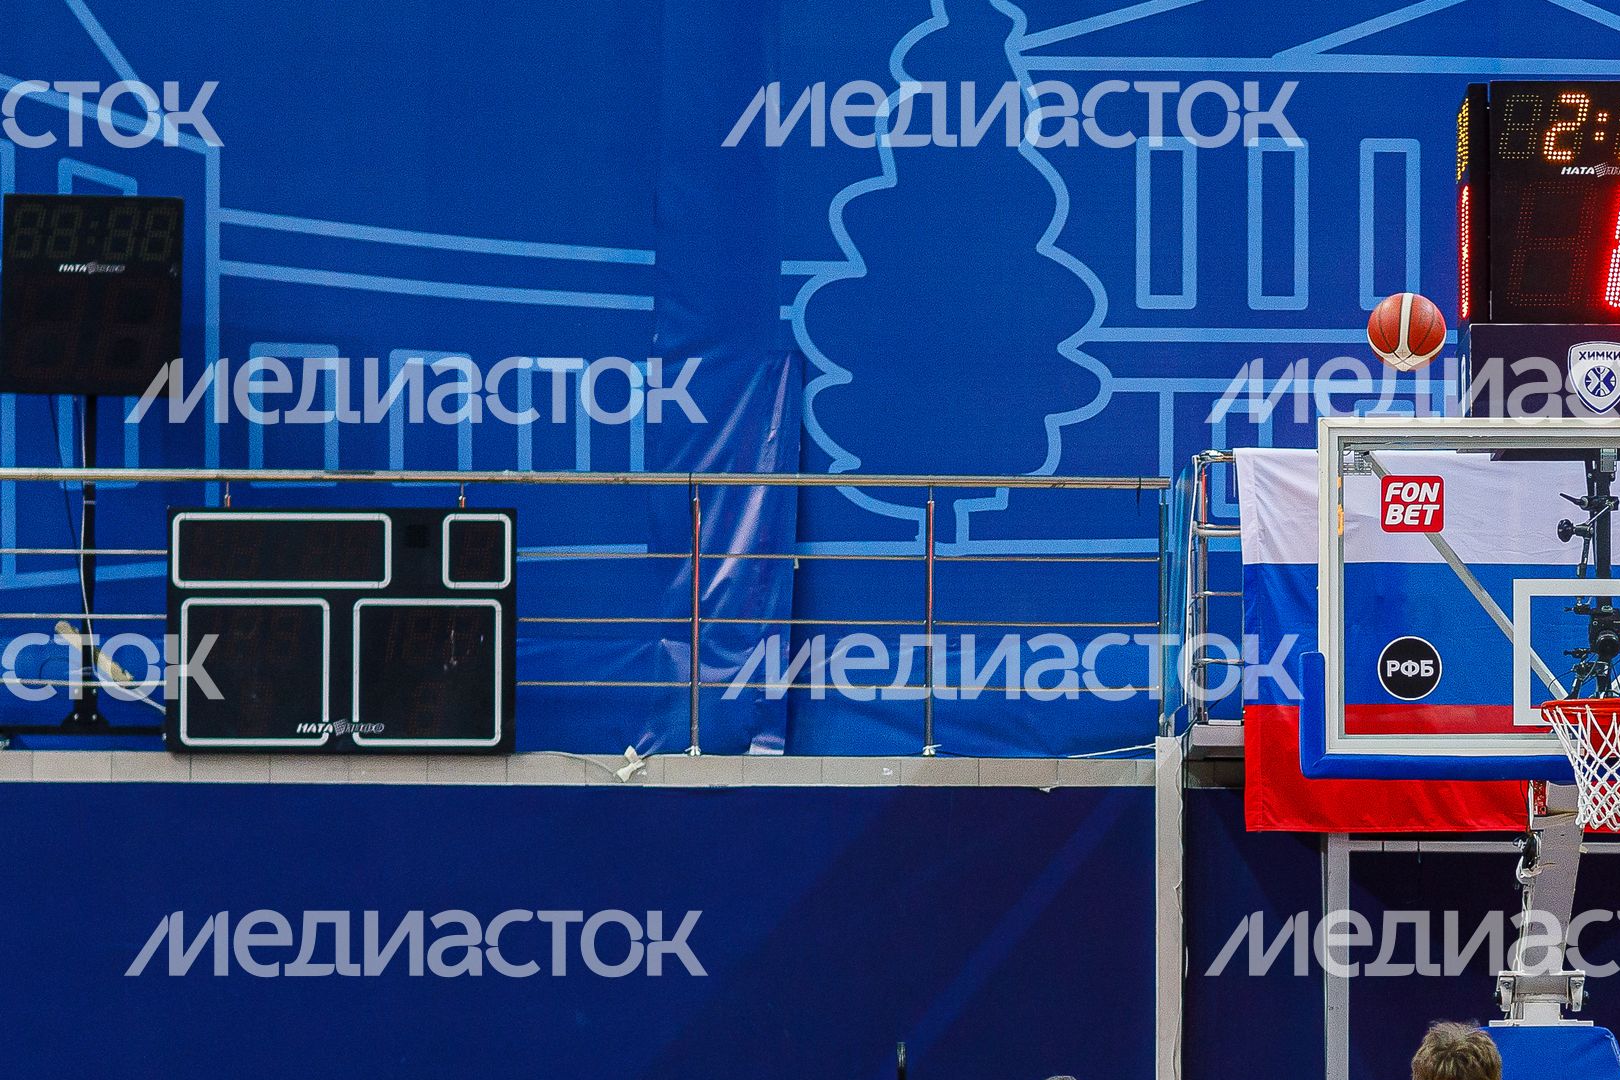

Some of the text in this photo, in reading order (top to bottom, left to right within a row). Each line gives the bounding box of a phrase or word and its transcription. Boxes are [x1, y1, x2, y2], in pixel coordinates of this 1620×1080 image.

[1561, 167, 1594, 175] НАТА
[1579, 351, 1620, 360] ХИМКИ
[1385, 482, 1440, 502] FON
[1385, 504, 1440, 525] BET
[1386, 660, 1434, 677] РФБ
